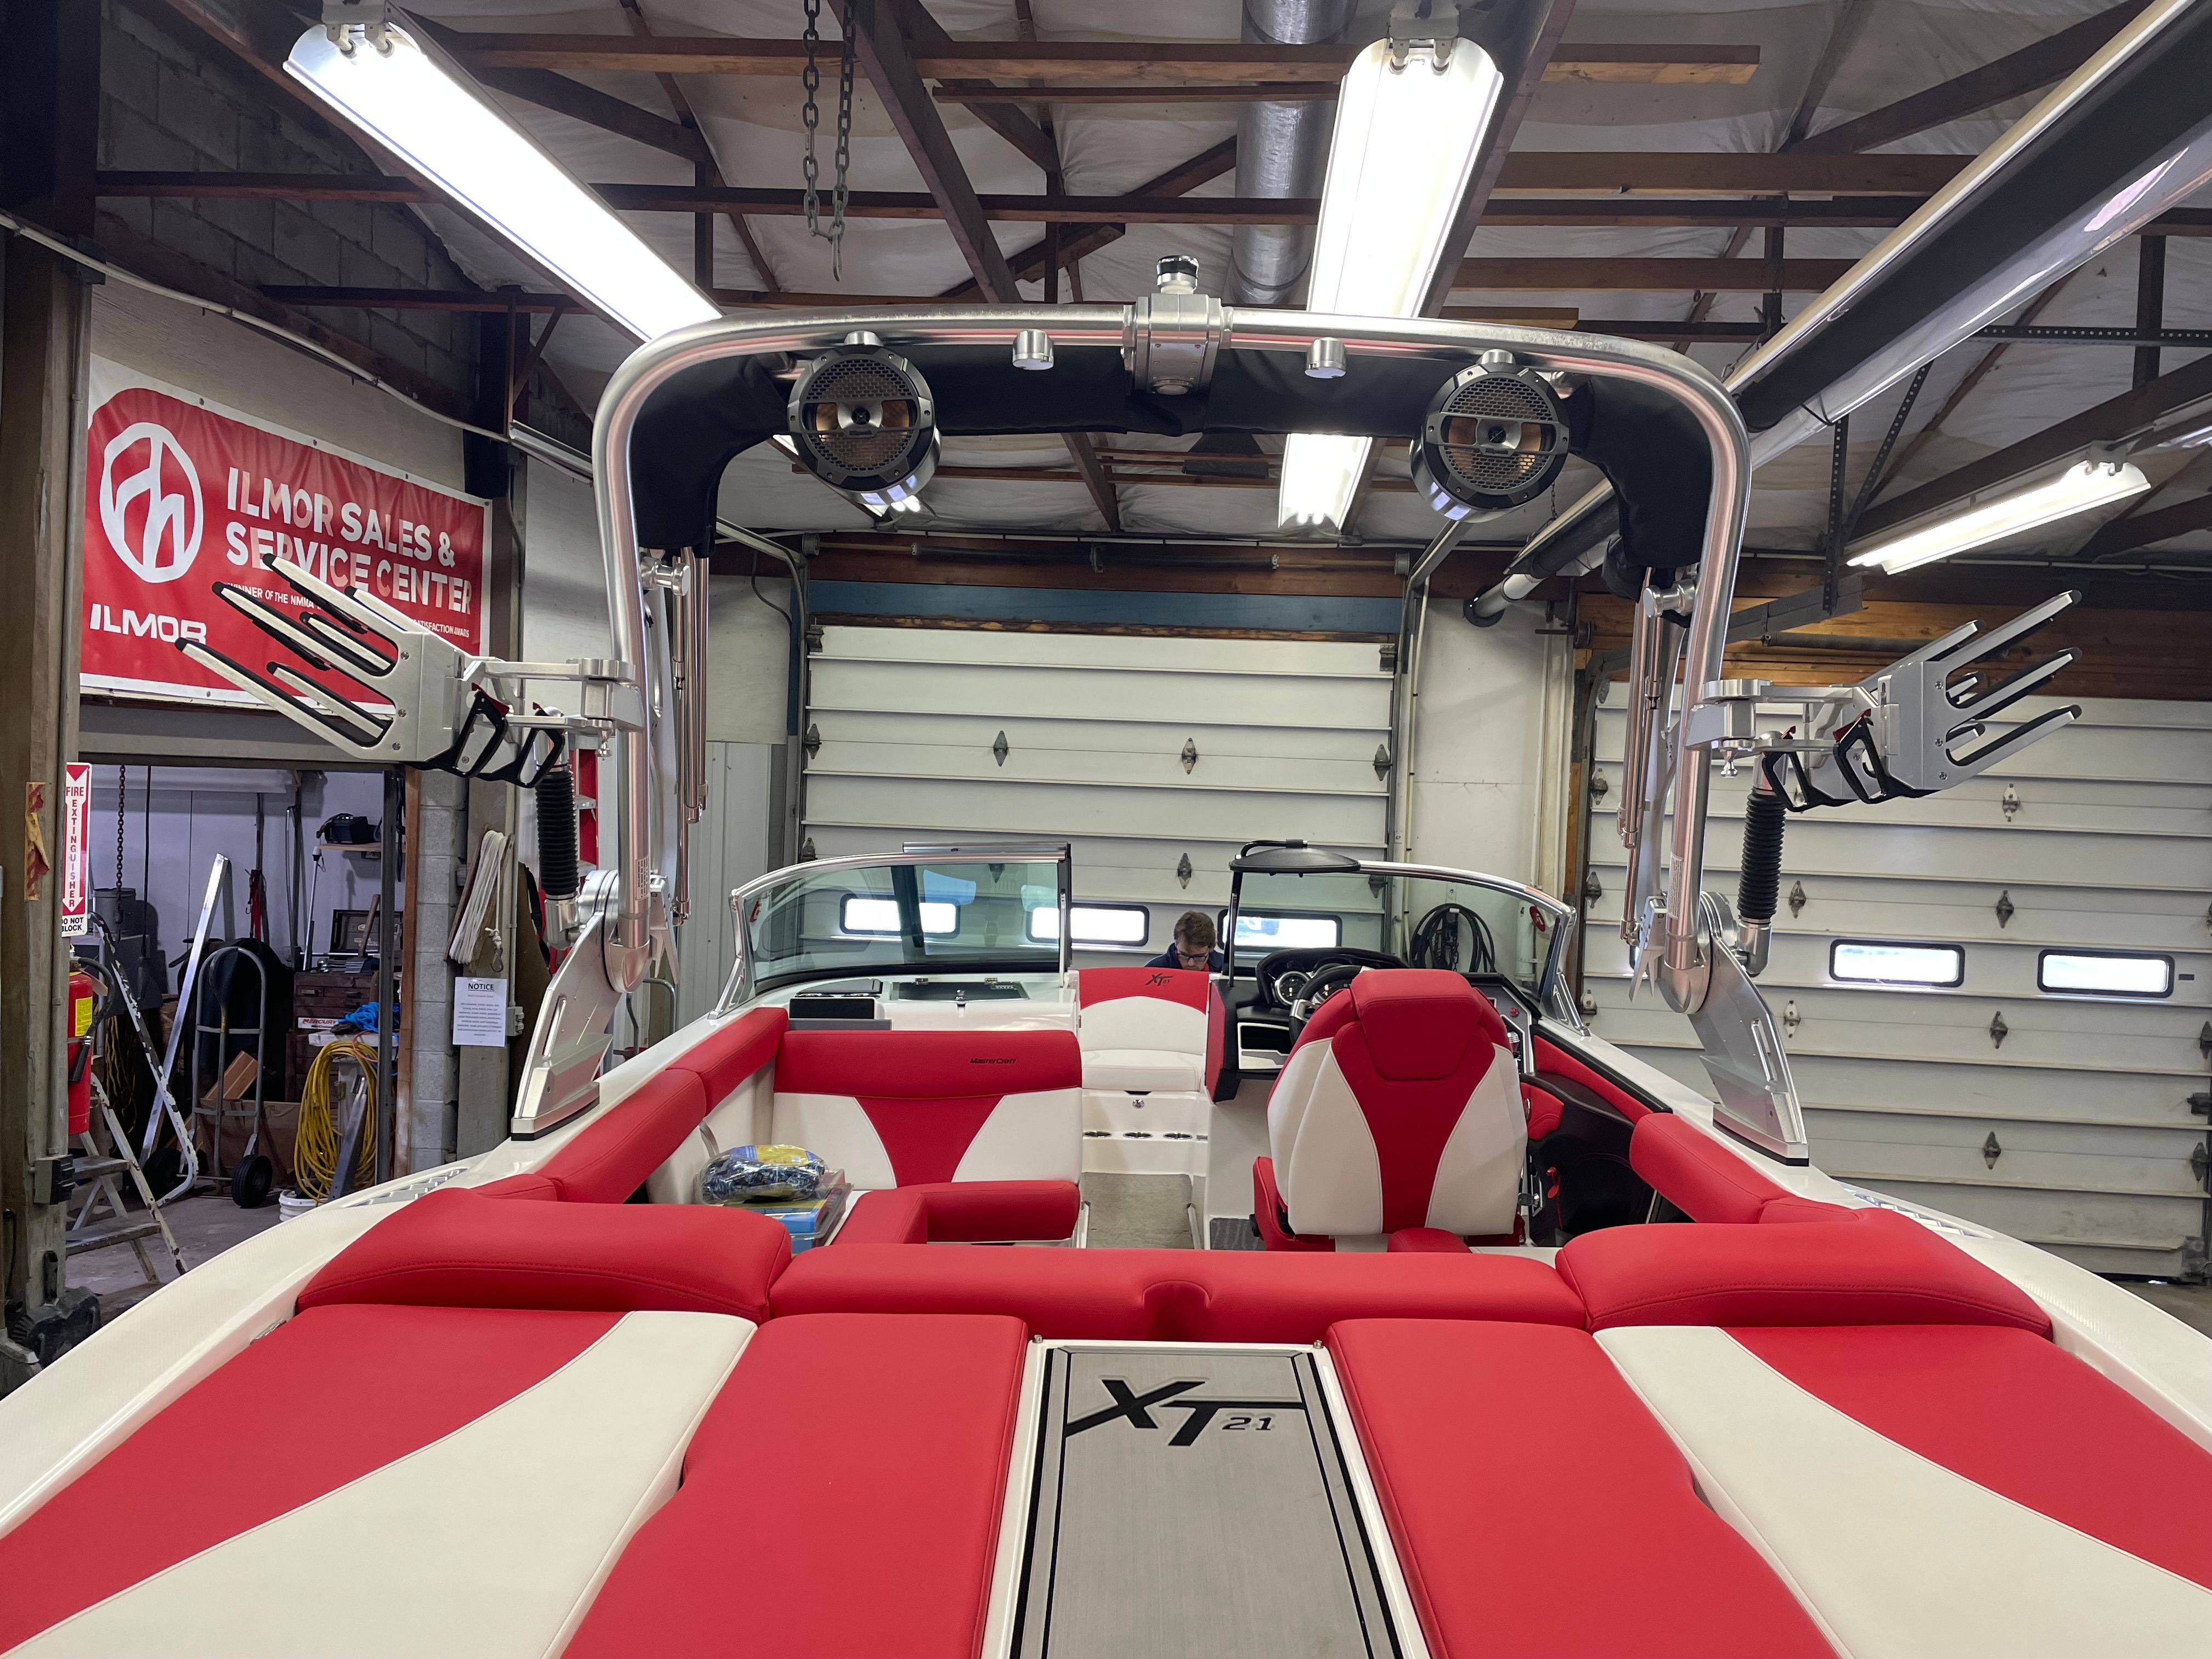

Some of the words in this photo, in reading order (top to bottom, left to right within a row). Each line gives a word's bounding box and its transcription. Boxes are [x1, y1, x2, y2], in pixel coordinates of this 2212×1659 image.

[227, 467, 334, 537] ILMOR
[341, 502, 432, 561] SALES
[438, 532, 455, 568] &
[225, 521, 371, 592] SERVICE
[376, 560, 472, 615] CENTER
[265, 589, 274, 600] OF
[274, 591, 288, 603] THE
[290, 595, 314, 609] NMMA
[90, 603, 207, 645] ILMOR
[65, 786, 84, 797] FIRE
[69, 799, 78, 908] EXTINGUISHER
[1065, 1379, 1306, 1447] XT
[1222, 1416, 1273, 1431] 21
